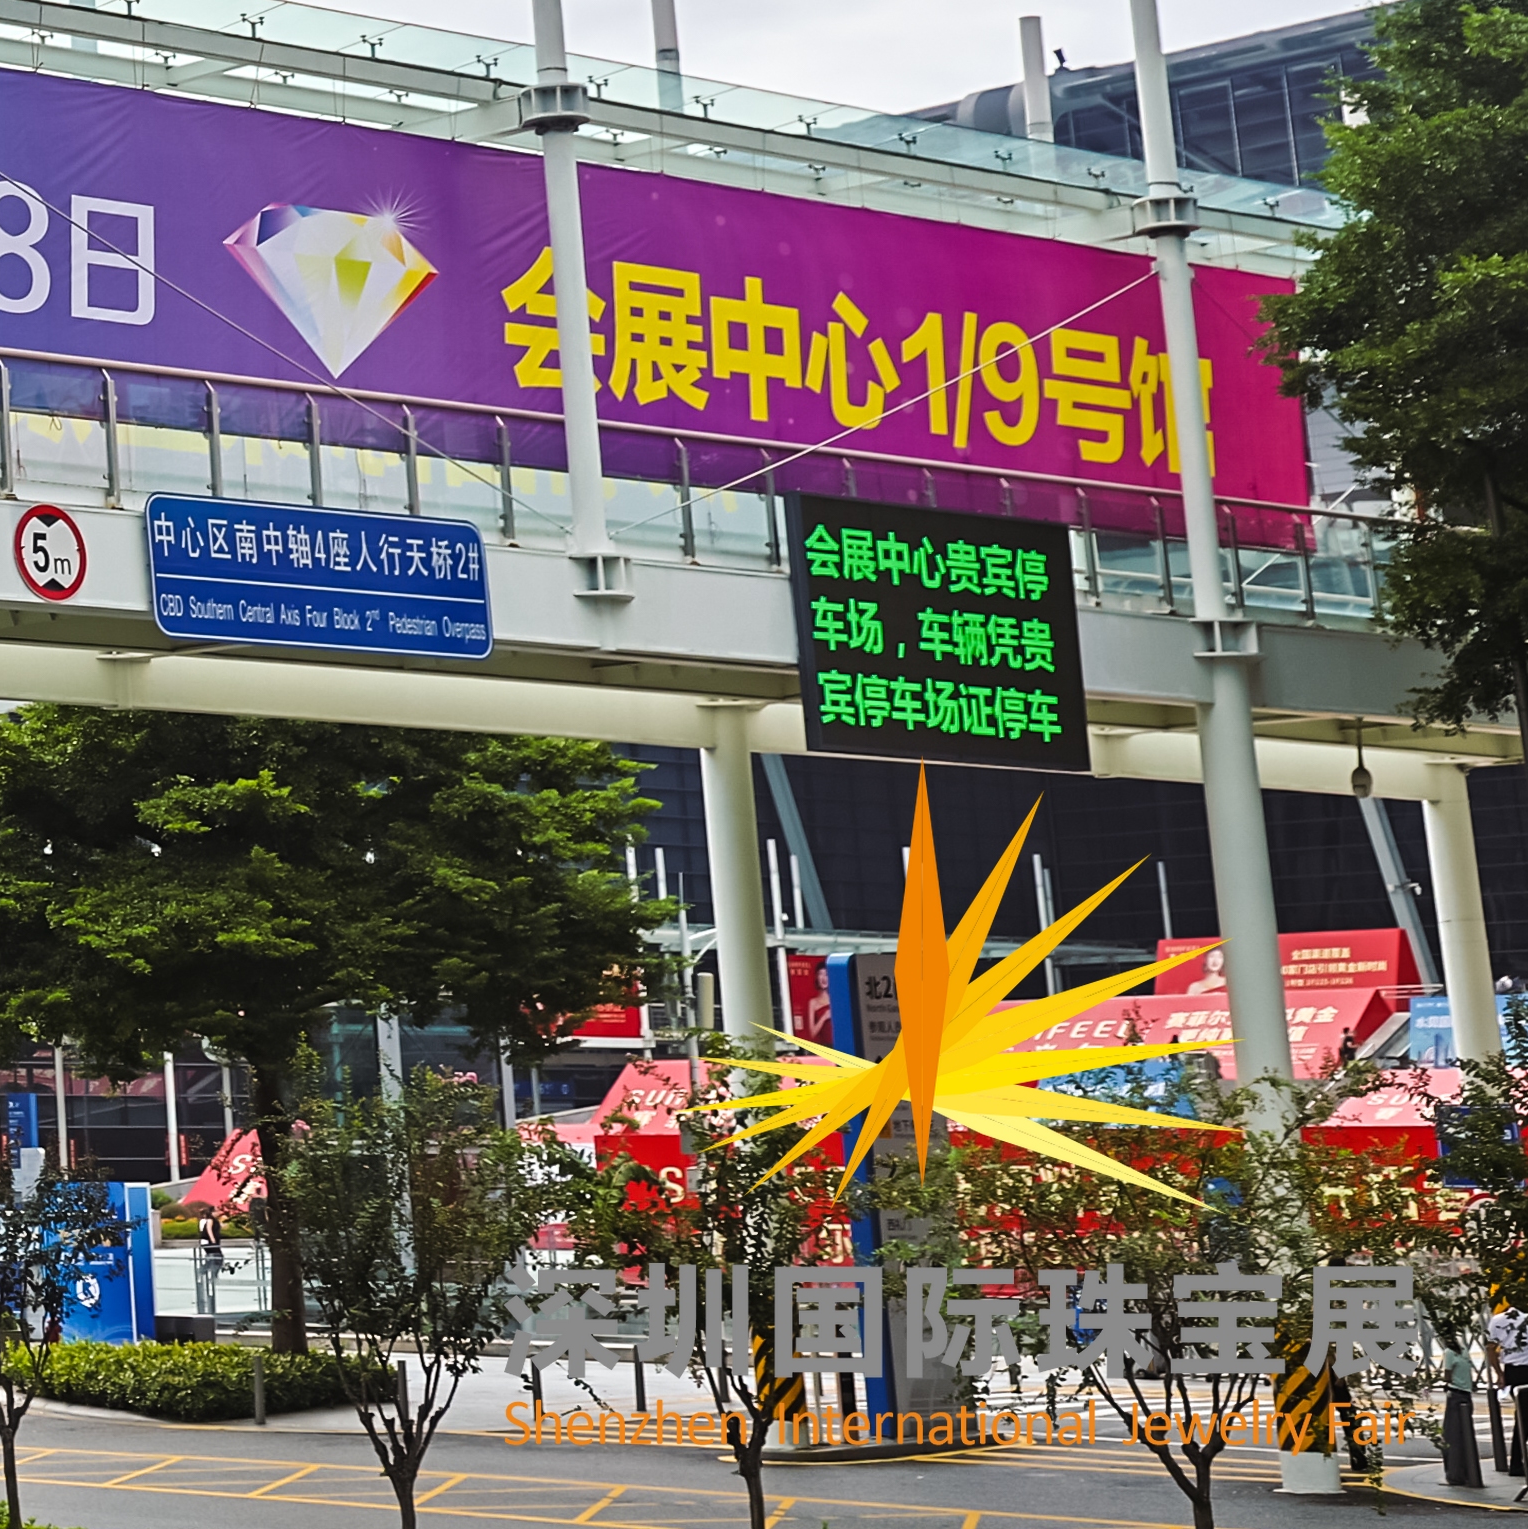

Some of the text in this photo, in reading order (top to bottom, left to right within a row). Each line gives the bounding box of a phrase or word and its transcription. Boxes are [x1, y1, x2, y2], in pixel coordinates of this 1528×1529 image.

[500, 245, 1217, 477] 会展中心1/9号馆
[153, 511, 480, 582] 中心区南中轴4座人行天桥2#
[804, 524, 1049, 601] 会展中心贵宾停
[160, 593, 183, 617] CBD
[189, 596, 234, 621] Southern
[239, 600, 275, 624] Central
[280, 604, 300, 626] Axis
[306, 605, 327, 629] Four
[334, 608, 360, 630] Block
[389, 612, 438, 637] Pedestrian
[443, 616, 487, 642] Overpass
[817, 669, 1063, 743] 宾停车场证停车
[865, 975, 899, 1000] 北2
